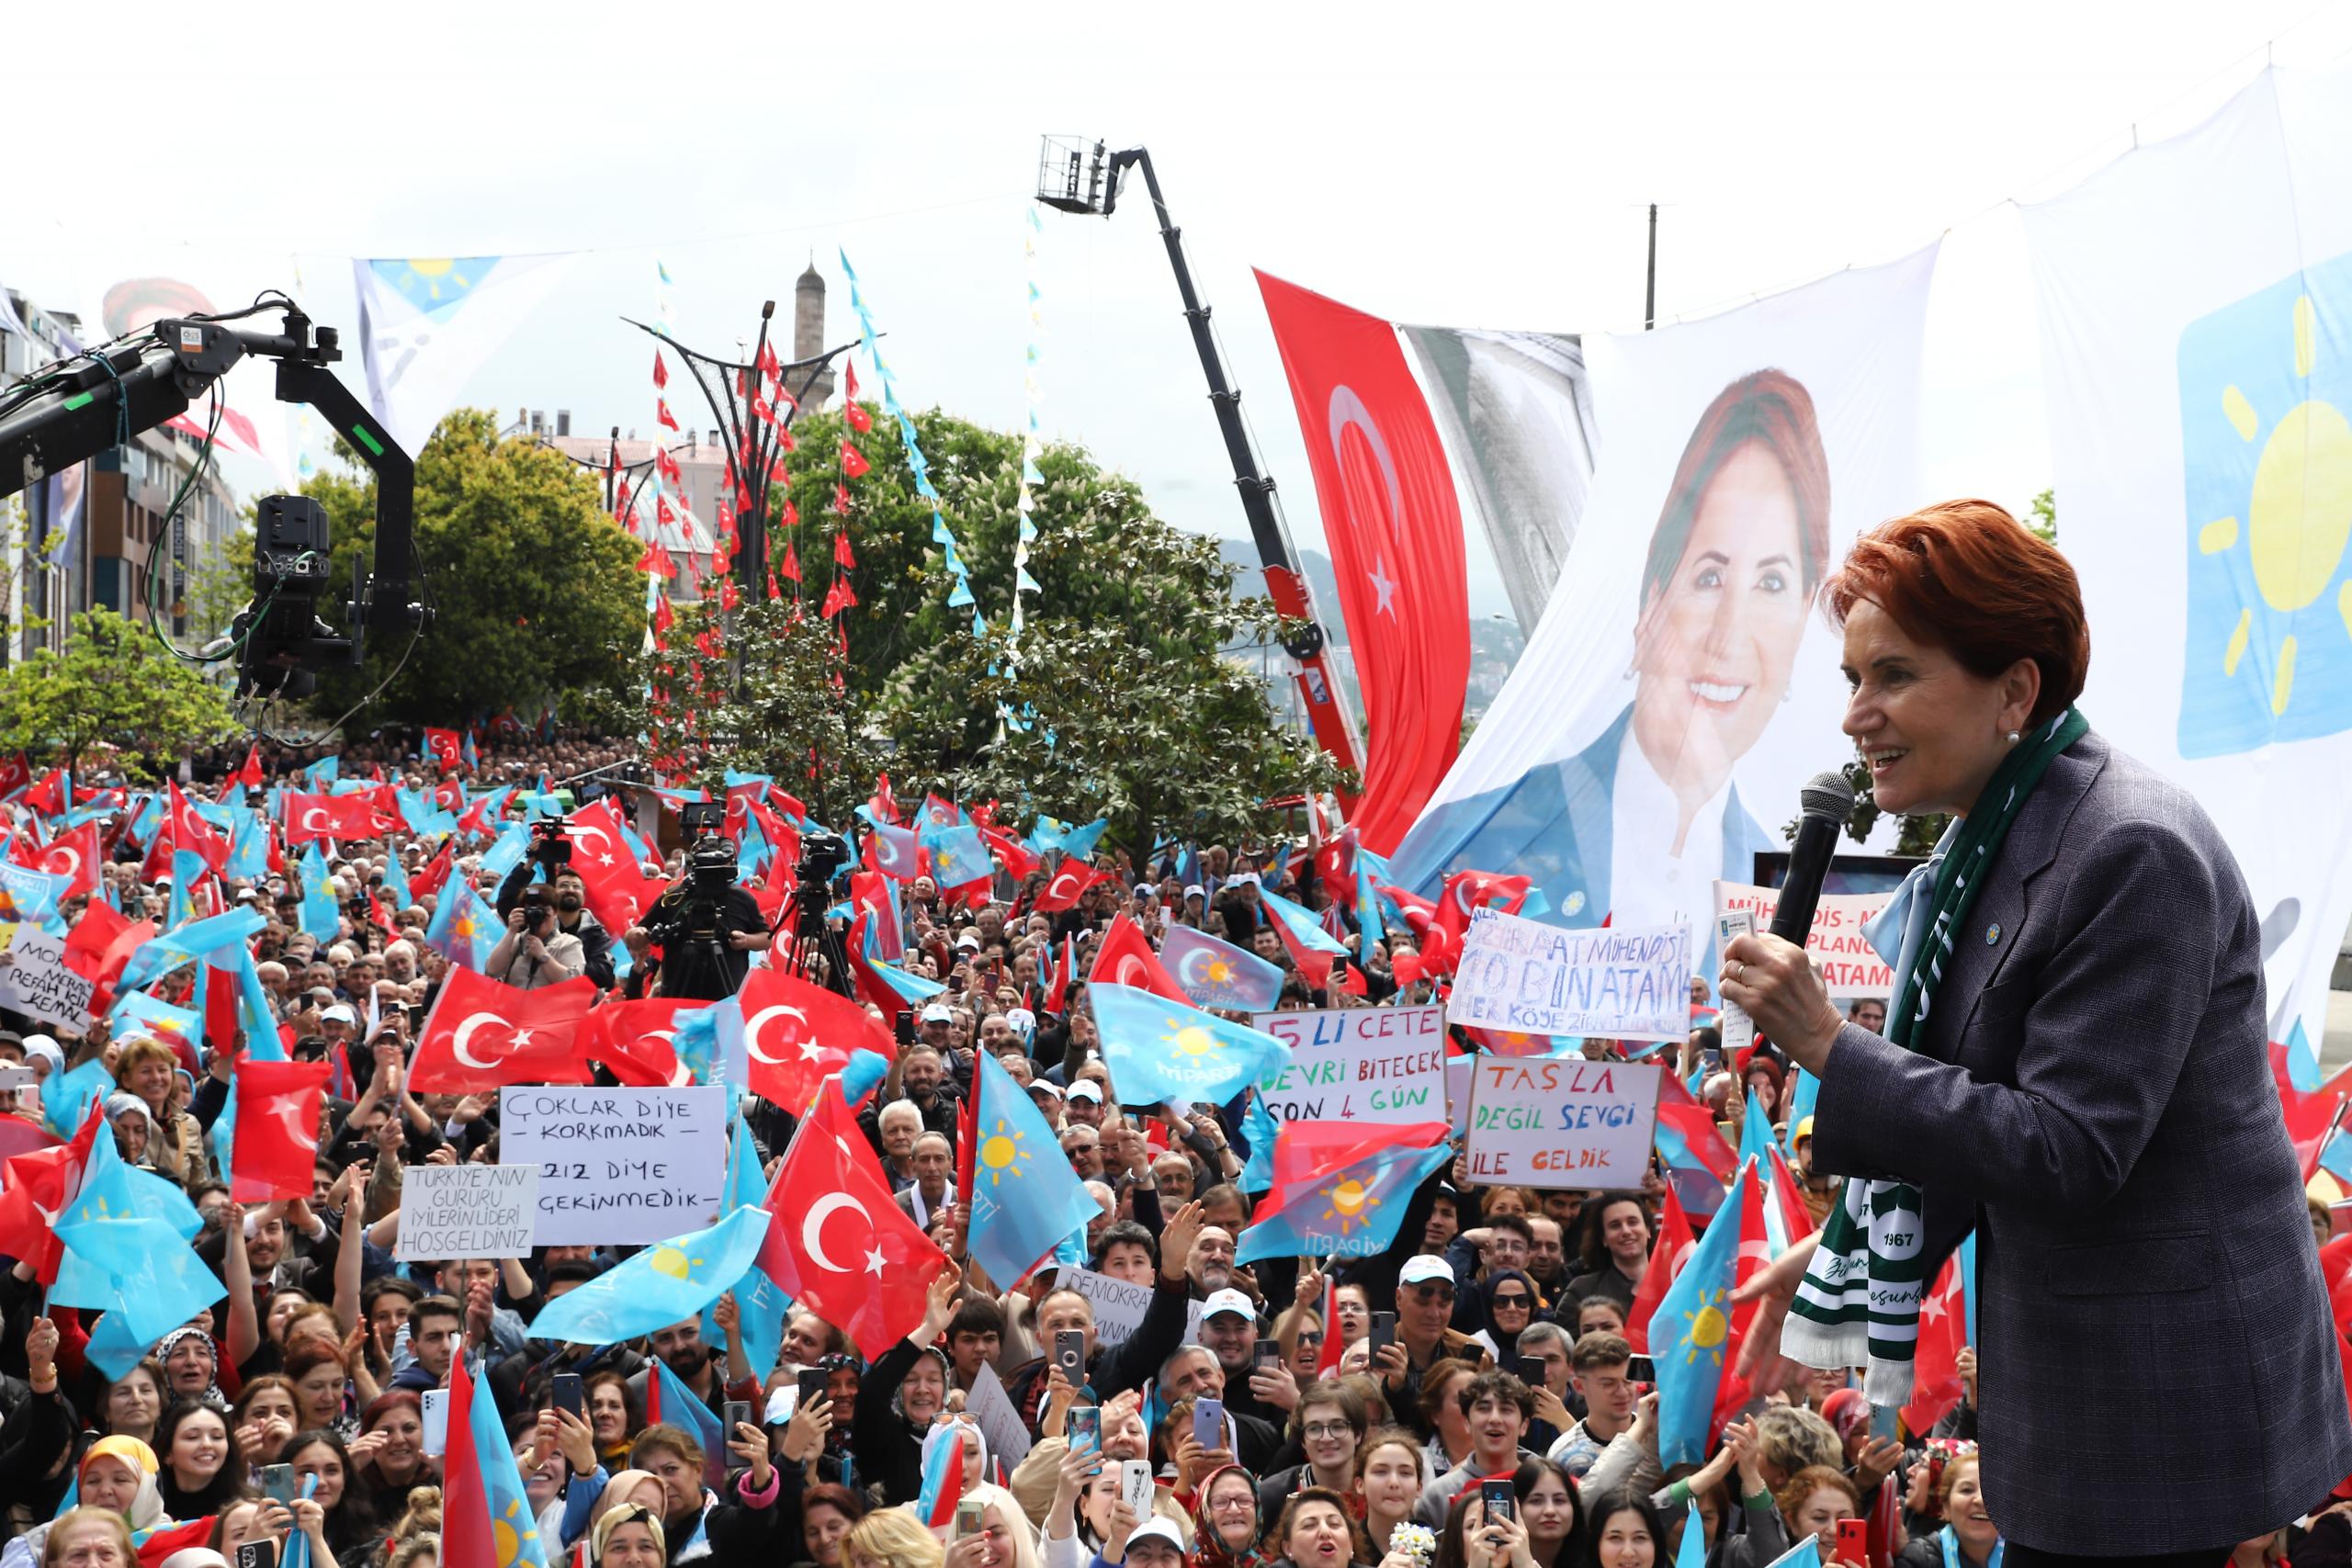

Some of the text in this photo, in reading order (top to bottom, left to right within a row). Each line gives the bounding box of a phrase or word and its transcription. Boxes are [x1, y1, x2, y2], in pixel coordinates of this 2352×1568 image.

[9, 967, 59, 997] REFAH
[19, 992, 86, 1029] KEMAL
[1269, 1010, 1438, 1048] 5 Lİ ÇETE
[1261, 1050, 1441, 1091] DEVRİ BİTECEK
[506, 1094, 692, 1122] ÇOKLAR DİYE
[1267, 1085, 1429, 1122] SON 4 GÜN
[1476, 1102, 1636, 1130] DEĞİL SEVGİ
[540, 1122, 665, 1140] KORKMADIK
[606, 1158, 668, 1180] DİYE
[1472, 1148, 1611, 1175] İLE GELDİK
[432, 1189, 503, 1208] GURURU
[1883, 1234, 1914, 1247] 1967
